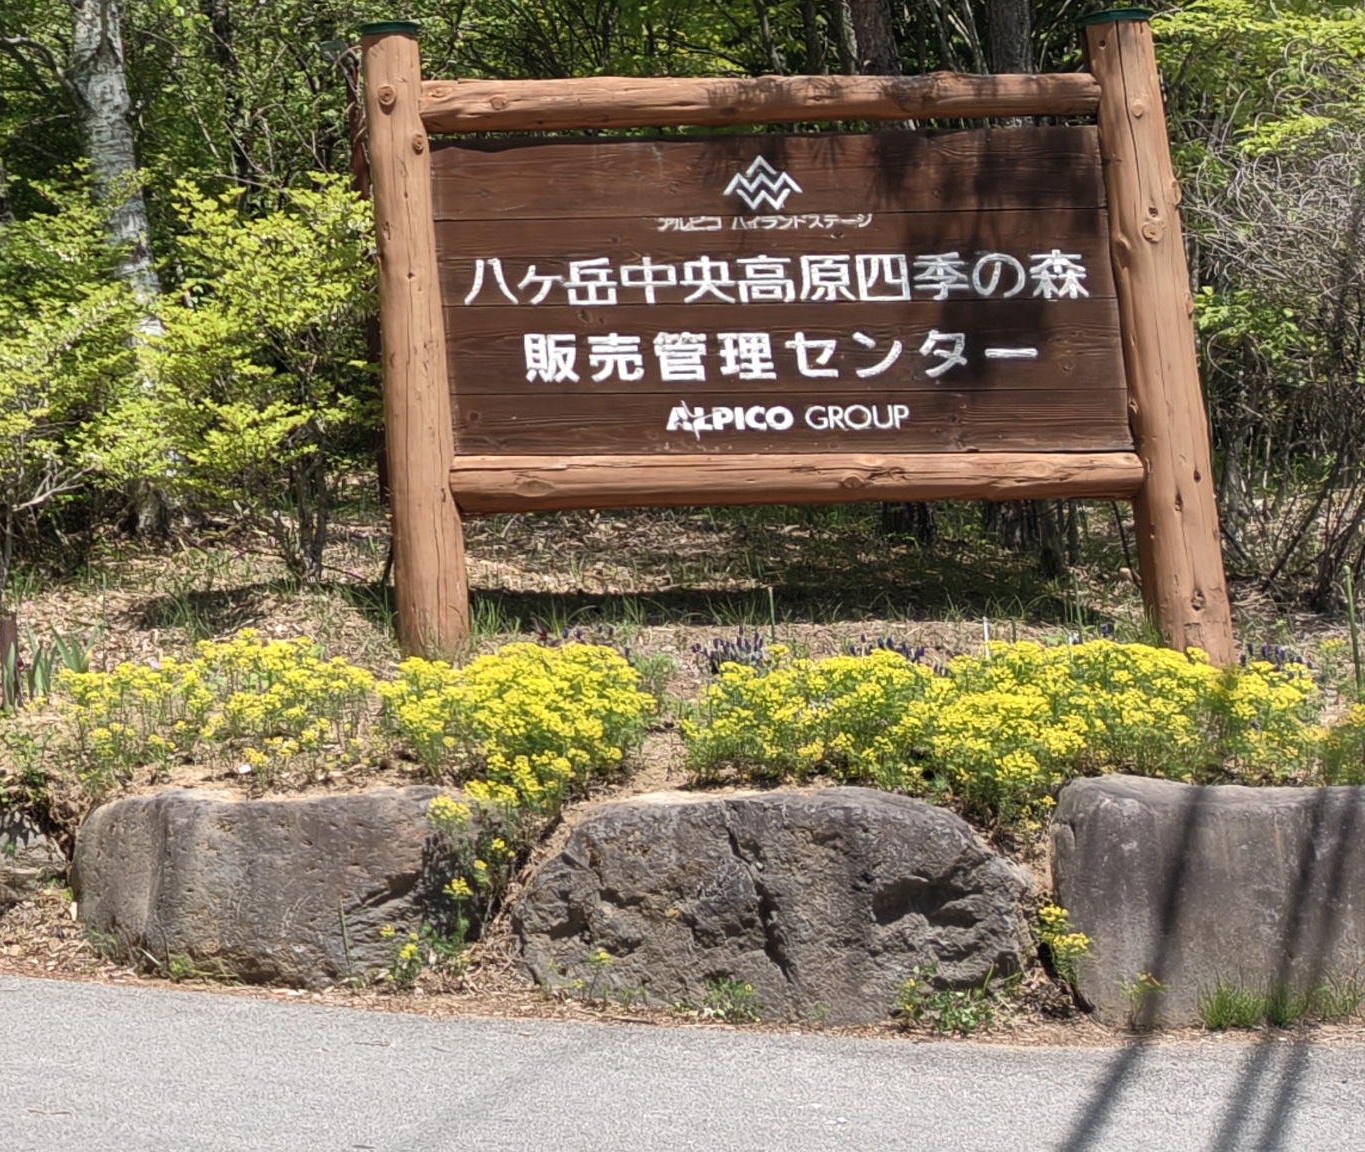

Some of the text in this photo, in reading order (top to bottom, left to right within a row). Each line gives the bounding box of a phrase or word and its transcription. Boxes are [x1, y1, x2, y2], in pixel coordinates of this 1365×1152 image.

[657, 213, 873, 231] アルピコ ハイランドステージ
[464, 250, 1090, 305] 八ヶ岳中央高原四季の森
[523, 329, 1039, 383] 販売管理センター
[666, 403, 909, 434] ALPICO GROUP
